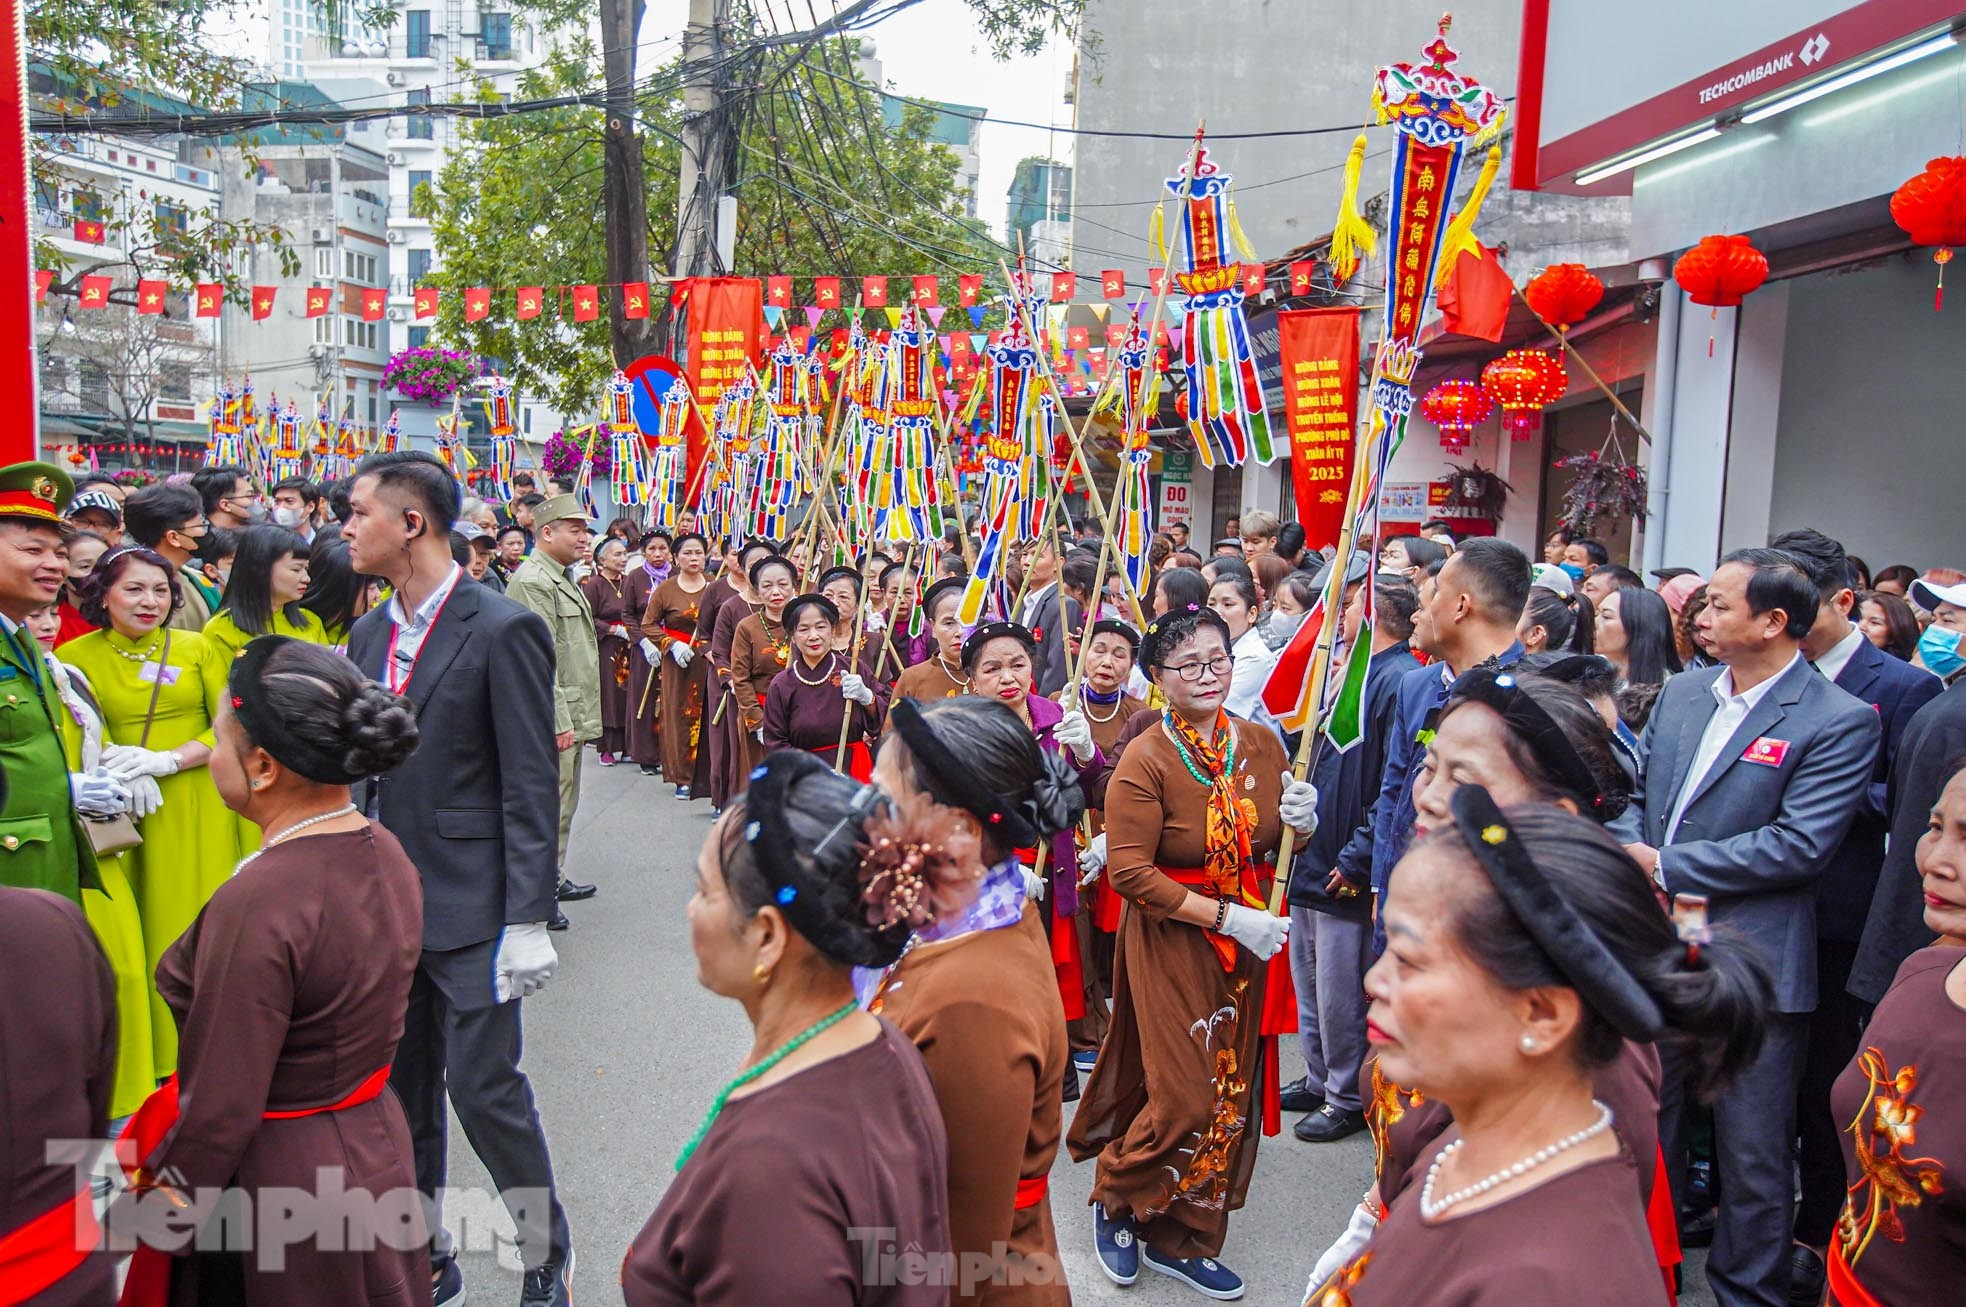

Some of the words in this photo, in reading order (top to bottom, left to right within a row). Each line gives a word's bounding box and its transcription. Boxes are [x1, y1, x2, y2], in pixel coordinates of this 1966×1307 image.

[1699, 52, 1793, 104] TECHCOMBANK
[1318, 356, 1339, 371] ĐẢNG
[1320, 376, 1340, 389] XUÂN
[1305, 446, 1325, 460] XUÂN
[1309, 466, 1344, 481] 2025
[1167, 486, 1186, 502] ĐO
